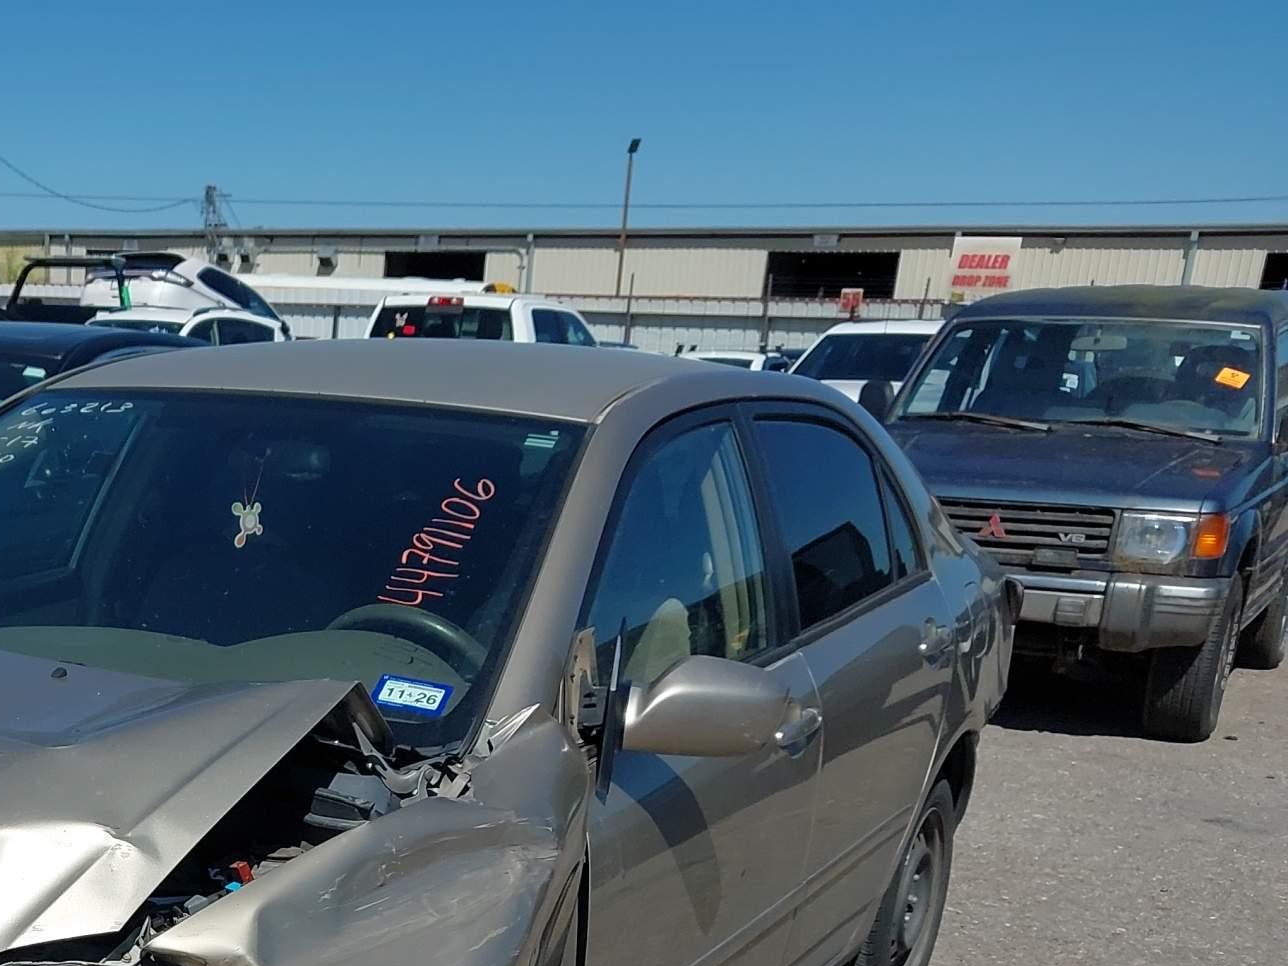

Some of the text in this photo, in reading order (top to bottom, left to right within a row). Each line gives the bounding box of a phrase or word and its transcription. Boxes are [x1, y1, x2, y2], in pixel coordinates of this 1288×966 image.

[958, 254, 1010, 269] DEALER
[952, 275, 1011, 288] DROP ZONE
[377, 477, 496, 606] 44791106
[1057, 532, 1086, 543] V6
[386, 687, 406, 700] 11
[414, 692, 439, 705] 26
